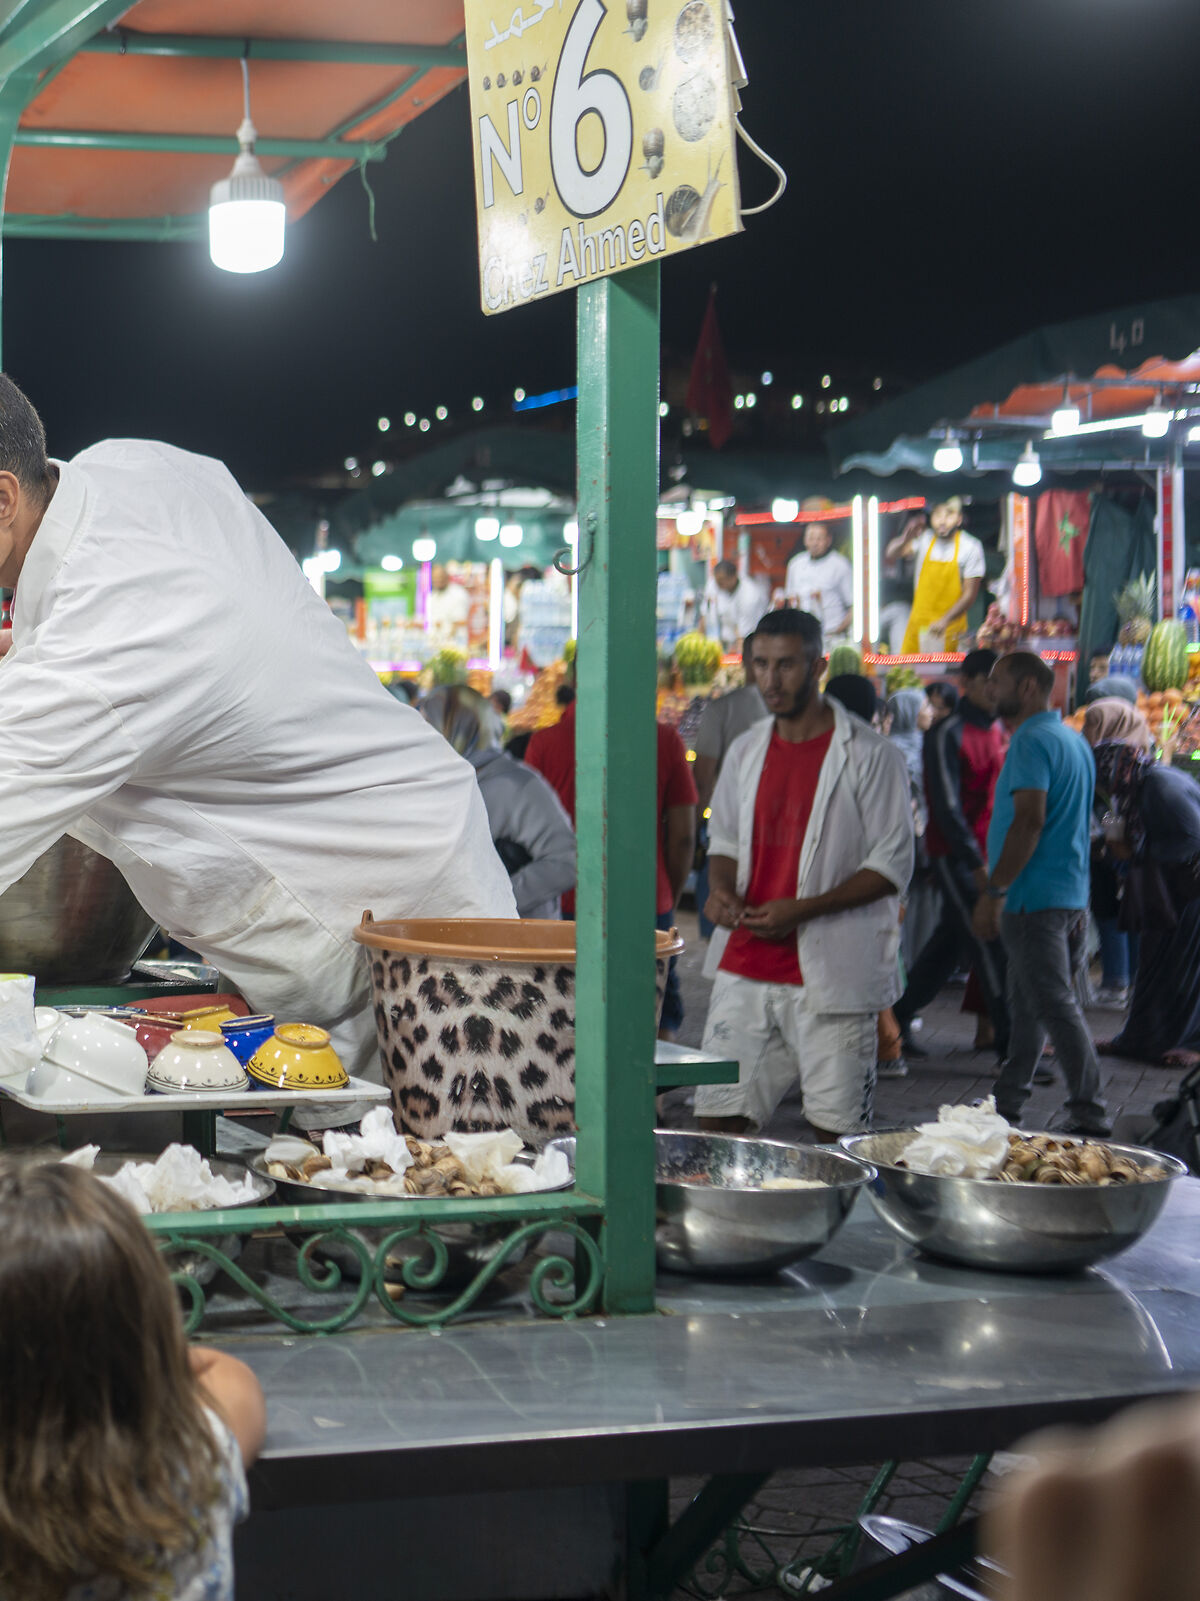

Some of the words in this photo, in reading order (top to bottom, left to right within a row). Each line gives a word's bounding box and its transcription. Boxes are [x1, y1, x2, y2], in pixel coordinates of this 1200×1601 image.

[549, 0, 634, 220] 6
[483, 252, 549, 310] Chez
[556, 192, 667, 286] Ahmed
